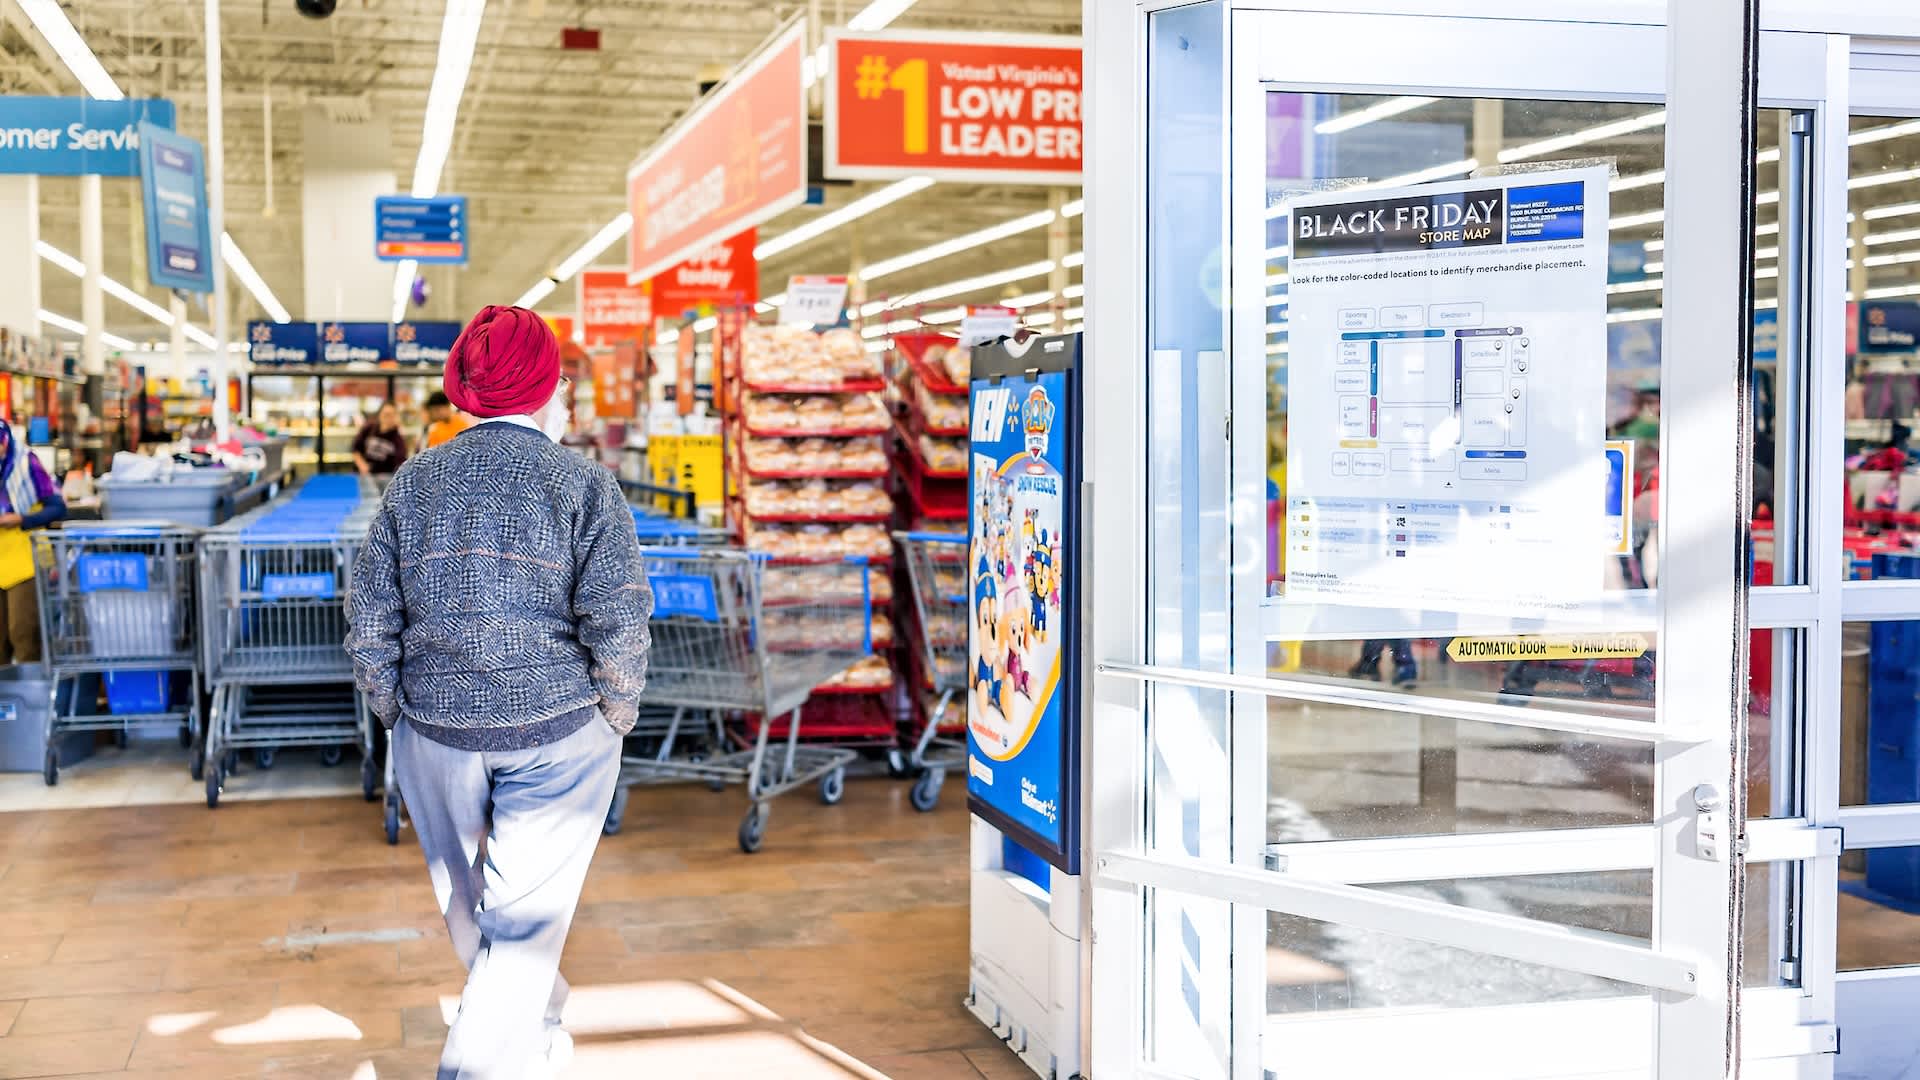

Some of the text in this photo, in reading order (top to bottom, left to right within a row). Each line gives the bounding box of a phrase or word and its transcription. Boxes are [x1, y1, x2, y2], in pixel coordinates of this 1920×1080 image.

[941, 62, 1079, 87] Voted Virginia's
[854, 55, 929, 154] #1
[941, 86, 1024, 118] LOW
[0, 126, 62, 150] mer
[940, 122, 1081, 159] LEADER
[1299, 199, 1498, 239] BLACK FRIDAY
[1419, 228, 1491, 244] STORE MAP
[677, 268, 734, 291] today
[1292, 260, 1586, 284] Look for the color-coded locations to identify merchandise placement.
[971, 388, 1011, 442] NEW
[1021, 398, 1055, 434] PAW
[1033, 476, 1057, 496] RESCUE
[1305, 572, 1326, 580] supplies
[1458, 636, 1638, 657] AUTOMATIC DOOR STAND CLEAR
[1021, 788, 1047, 816] Walmart
